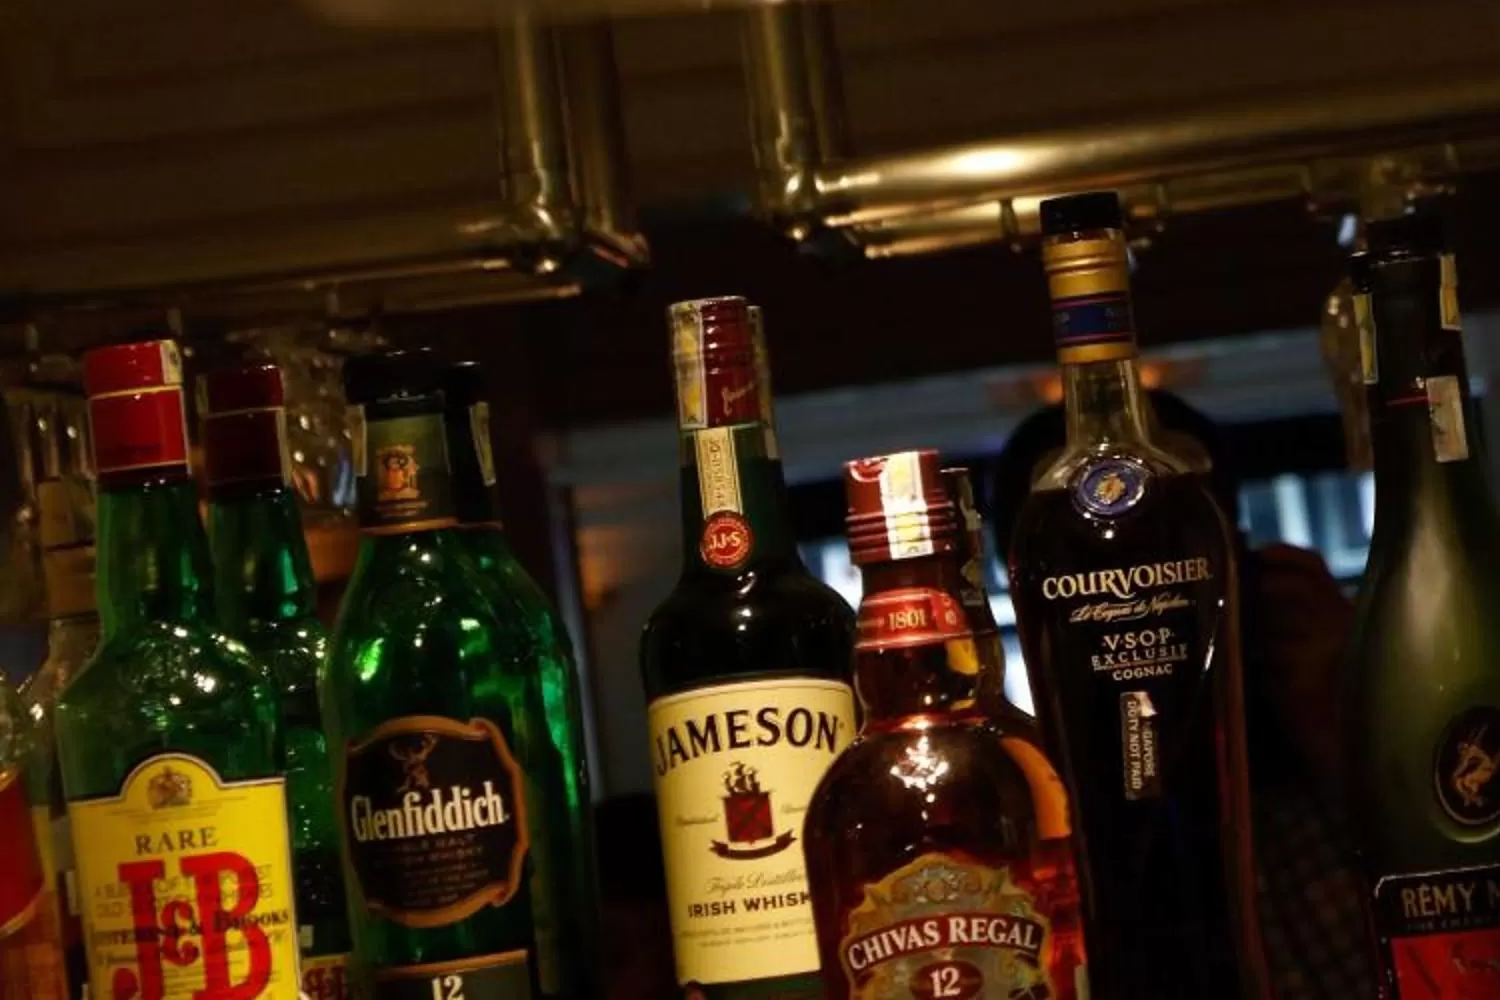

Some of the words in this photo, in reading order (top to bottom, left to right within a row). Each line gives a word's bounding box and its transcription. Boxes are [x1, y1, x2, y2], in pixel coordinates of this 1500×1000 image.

[1041, 556, 1210, 600] COURVOISIER
[888, 609, 928, 631] 1801
[1112, 663, 1173, 682] COGNAC
[656, 707, 838, 777] JAMESON
[351, 780, 506, 843] Glenfiddich
[134, 825, 218, 855] RARE
[112, 851, 273, 1000] J&B
[688, 900, 736, 919] IRISH
[848, 918, 941, 970] CHIVAS
[947, 916, 1038, 950] REGAL
[431, 974, 466, 1000] 12
[930, 966, 962, 998] 12
